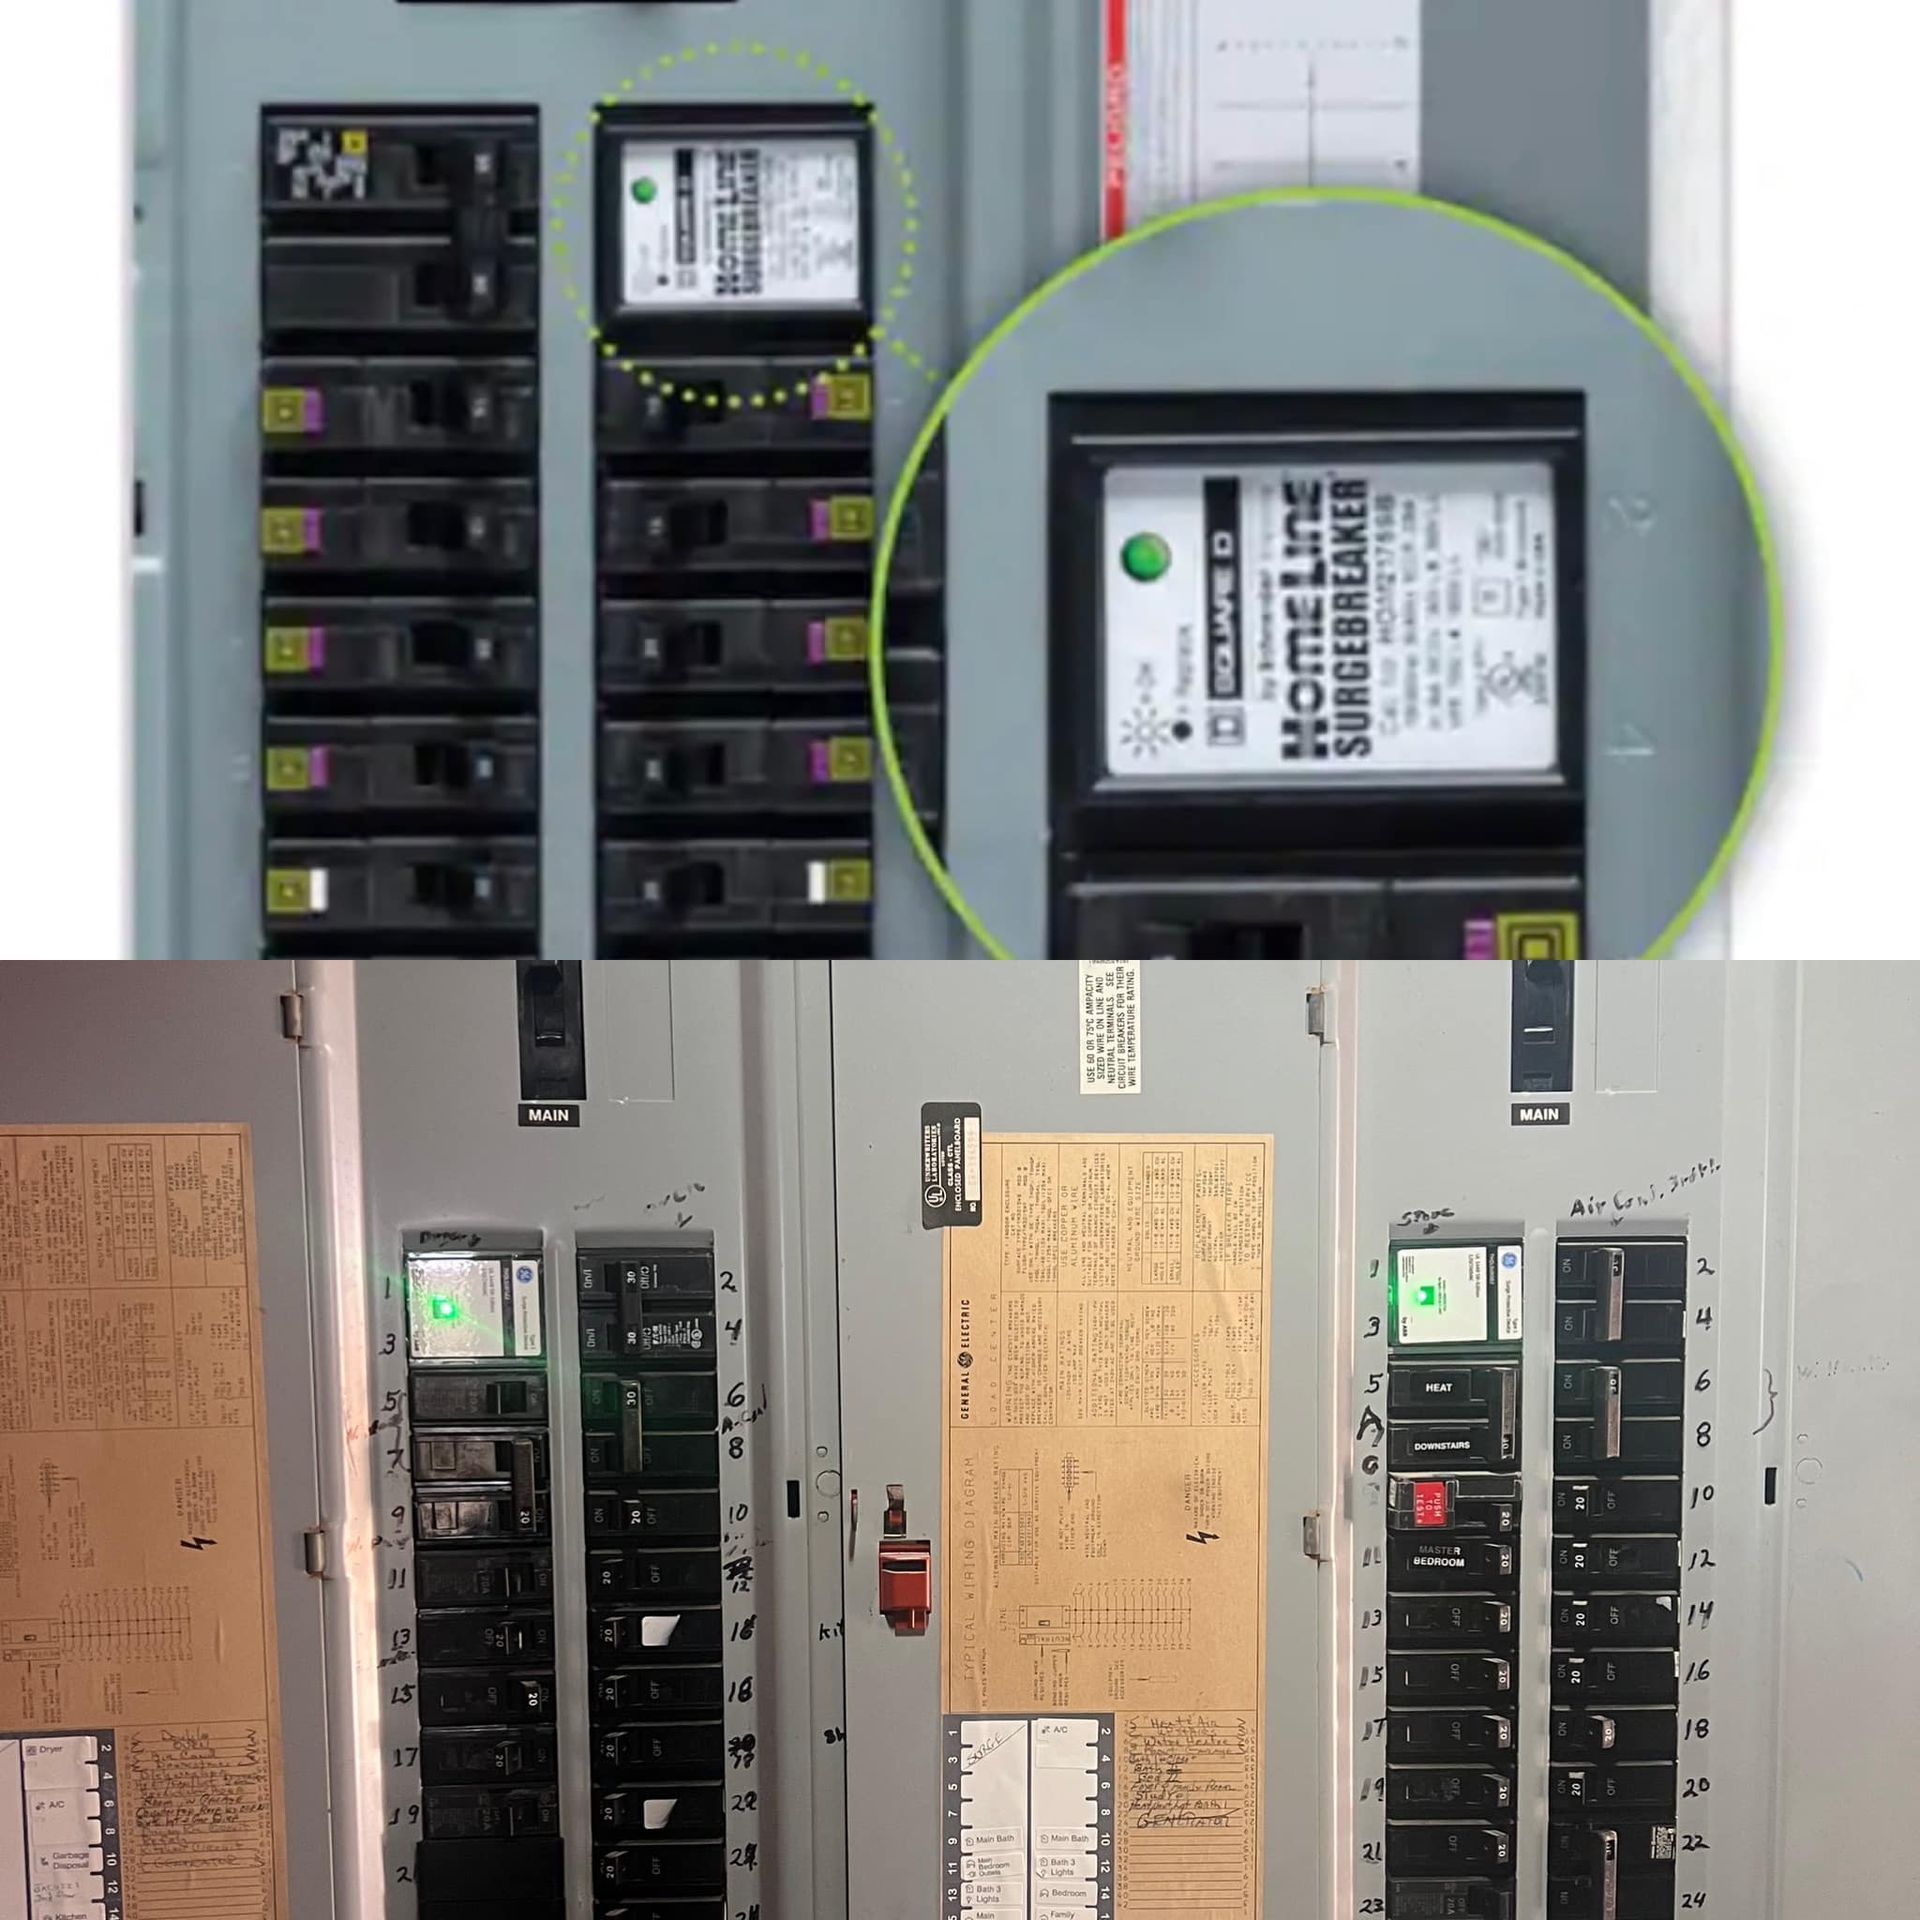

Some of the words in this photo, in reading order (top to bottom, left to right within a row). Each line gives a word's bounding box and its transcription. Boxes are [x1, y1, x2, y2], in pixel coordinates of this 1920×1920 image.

[1332, 479, 1370, 757] SURGEBREAKER
[1096, 977, 1104, 994] AND
[1106, 972, 1114, 987] SEE
[1116, 966, 1124, 989] THEIR
[1086, 974, 1094, 1015] AMPACITY
[1096, 997, 1104, 1015] LINE
[1096, 1019, 1104, 1030] ON
[1106, 997, 1114, 1043] TERMINALS
[1117, 1012, 1125, 1053] BREAKERS
[1127, 1004, 1135, 1062] TEMPERATURE
[1087, 1039, 1094, 1050] OR
[1096, 1033, 1104, 1053] WIRE
[1086, 1054, 1095, 1064] 60
[1107, 1047, 1115, 1083] NEUTRAL
[1087, 1067, 1095, 1083] USE
[1096, 1057, 1105, 1079] SIZED
[1118, 1058, 1126, 1089] CIRCUIT
[1128, 1067, 1136, 1086] WIRE
[529, 1109, 569, 1122] MAIN
[1520, 1108, 1559, 1122] MAIN
[1570, 1196, 1606, 1217] Air
[1562, 1258, 1571, 1273] ON
[1697, 1258, 1715, 1275] 2
[627, 1270, 636, 1284] 30
[720, 1271, 737, 1292] 2
[960, 1299, 970, 1348] ELECTRIC
[1564, 1316, 1573, 1331] ON
[1696, 1306, 1713, 1324] 4
[725, 1318, 742, 1341] 4
[1364, 1316, 1380, 1338] 3
[379, 1333, 395, 1355] 3
[628, 1331, 637, 1345] 30
[1364, 1373, 1383, 1393] 5
[1425, 1383, 1453, 1392] HEAT
[1563, 1374, 1573, 1389] ON
[1694, 1369, 1711, 1391] 6
[381, 1389, 401, 1411] 5
[627, 1391, 636, 1406] 30
[727, 1382, 745, 1407] 6
[960, 1371, 970, 1419] GENERAL
[1563, 1434, 1572, 1450] ON
[1696, 1422, 1711, 1447] 8
[729, 1437, 744, 1459] 8
[1414, 1441, 1471, 1450] DOWNSTAIRS
[964, 1456, 974, 1528] DIAGRAM
[1607, 1491, 1616, 1510] OFF
[1690, 1485, 1714, 1509] 10
[1425, 1500, 1432, 1511] TO
[1433, 1492, 1441, 1517] PUSH
[1575, 1497, 1585, 1510] 20
[632, 1510, 641, 1524] 20
[729, 1503, 748, 1524] 10
[1501, 1511, 1510, 1526] 20
[1419, 1546, 1462, 1555] MASTER
[1559, 1550, 1568, 1564] ON
[1608, 1549, 1619, 1567] OFF
[1413, 1557, 1465, 1567] BEDROOM
[1501, 1554, 1510, 1568] 20
[1574, 1554, 1584, 1568] 20
[1688, 1549, 1716, 1571] 12
[603, 1571, 611, 1585] 20
[964, 1540, 974, 1599] WIRING
[388, 1568, 406, 1590] 11
[732, 1581, 750, 1593] 12
[1362, 1609, 1381, 1629] 13
[1500, 1612, 1508, 1625] 20
[1575, 1613, 1585, 1626] 20
[1610, 1606, 1620, 1625] OFF
[1687, 1600, 1714, 1629] 14
[392, 1629, 410, 1649] 13
[605, 1629, 613, 1642] 20
[964, 1612, 975, 1681] TYPICAL
[1360, 1666, 1383, 1687] 15
[1571, 1671, 1581, 1684] 20
[1607, 1662, 1616, 1681] OFF
[1683, 1659, 1710, 1684] 16
[528, 1693, 538, 1706] 20
[1362, 1718, 1386, 1741] 17
[1499, 1725, 1508, 1740] 20
[1684, 1719, 1709, 1740] 18
[39, 1745, 63, 1753] Dryer
[393, 1747, 418, 1767] 17
[103, 1772, 113, 1780] 4
[948, 1783, 958, 1791] 5
[1360, 1778, 1384, 1801] 19
[1499, 1786, 1508, 1800] 20
[1571, 1783, 1581, 1796] 20
[1607, 1778, 1616, 1796] OFF
[1682, 1777, 1710, 1798] 20
[388, 1804, 419, 1826] 19
[604, 1807, 613, 1821] 20
[1363, 1842, 1382, 1860] 21
[1498, 1844, 1506, 1857] 20
[1682, 1835, 1710, 1851] 22
[53, 1852, 89, 1860] Garbage
[106, 1853, 117, 1866] 10
[53, 1861, 89, 1869] Disposal
[606, 1865, 615, 1879] 20
[978, 1862, 1010, 1870] Bedroom
[108, 1881, 119, 1894] 12
[1052, 1889, 1087, 1897] Bedroom
[976, 1895, 999, 1903] Lights
[1359, 1899, 1384, 1914] 23
[1681, 1893, 1706, 1908] 24
[1051, 1911, 1075, 1919] Family
